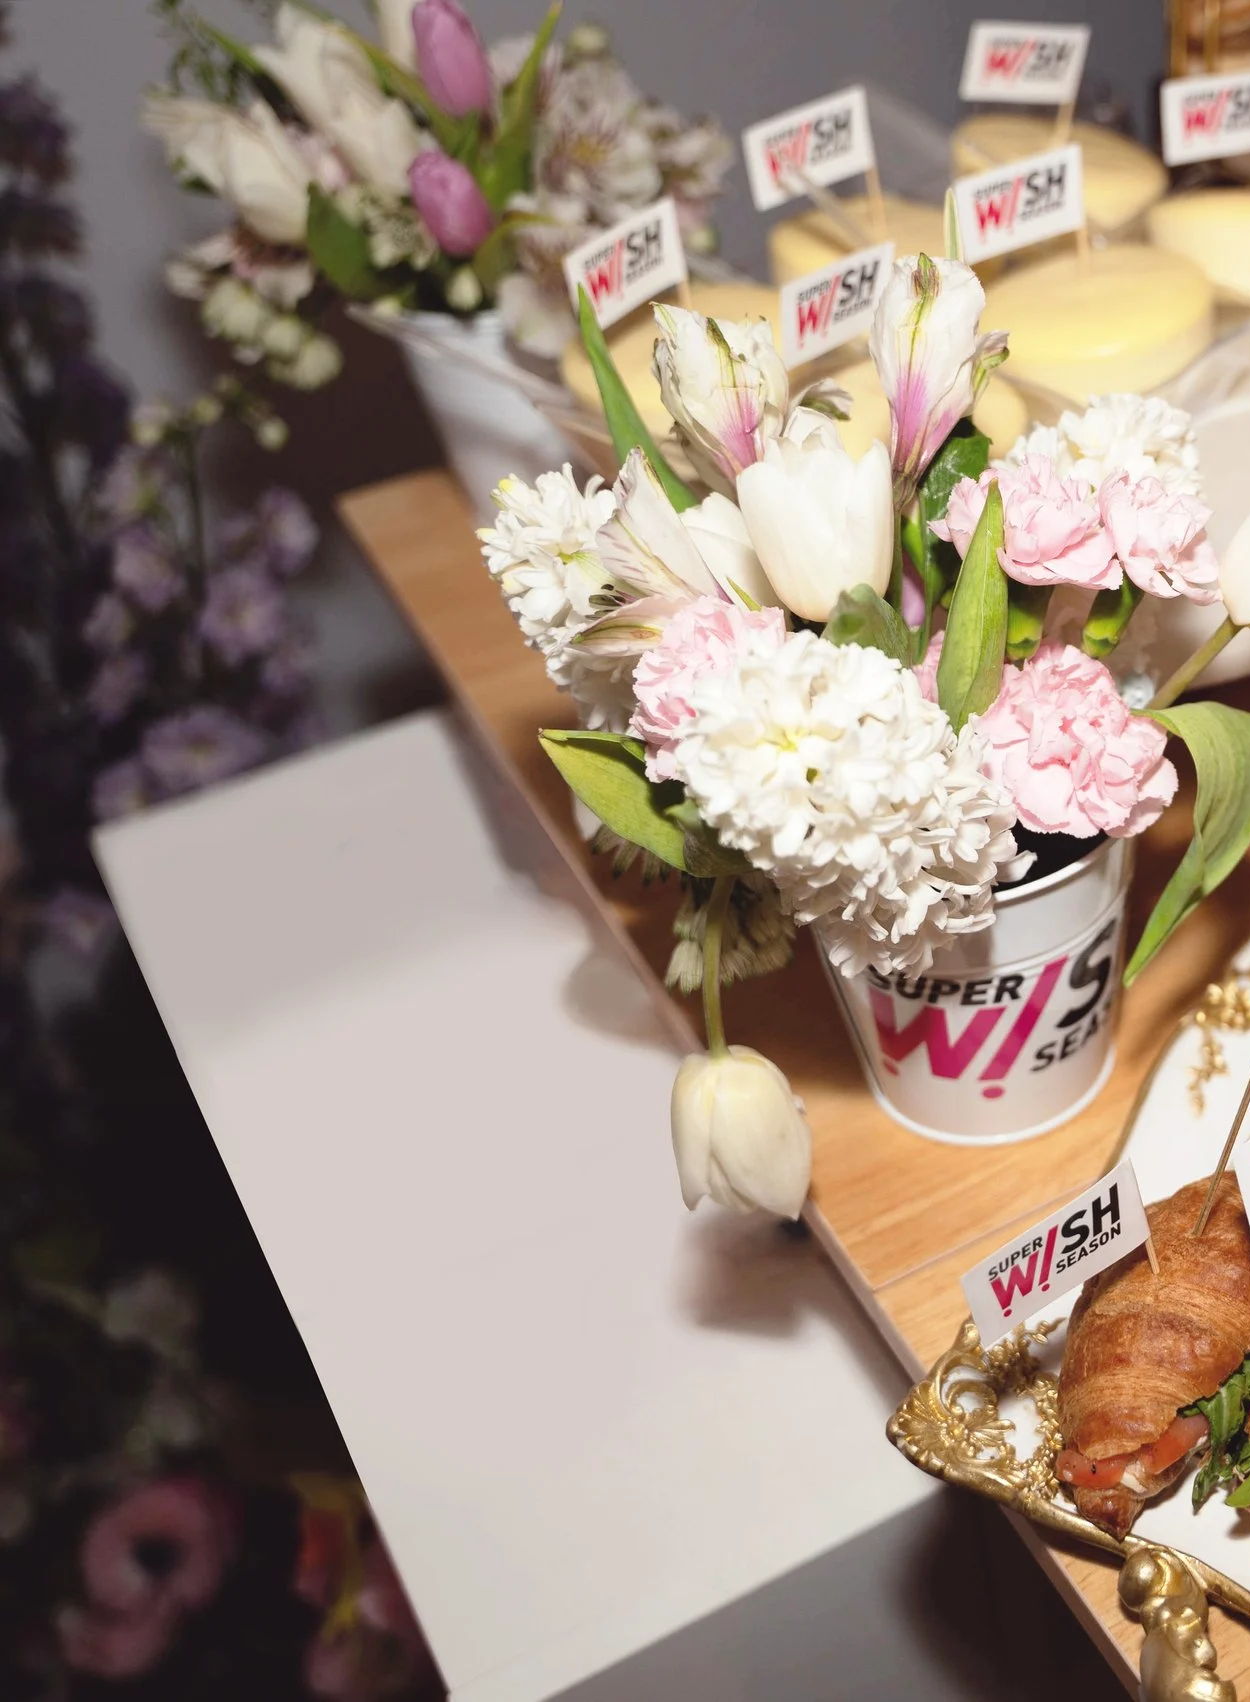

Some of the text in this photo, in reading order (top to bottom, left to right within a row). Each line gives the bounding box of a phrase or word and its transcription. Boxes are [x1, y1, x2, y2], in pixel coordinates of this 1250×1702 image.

[868, 964, 1025, 1006] SUPER
[988, 1236, 1043, 1281] SUPER
[1056, 1222, 1121, 1274] SEASON
